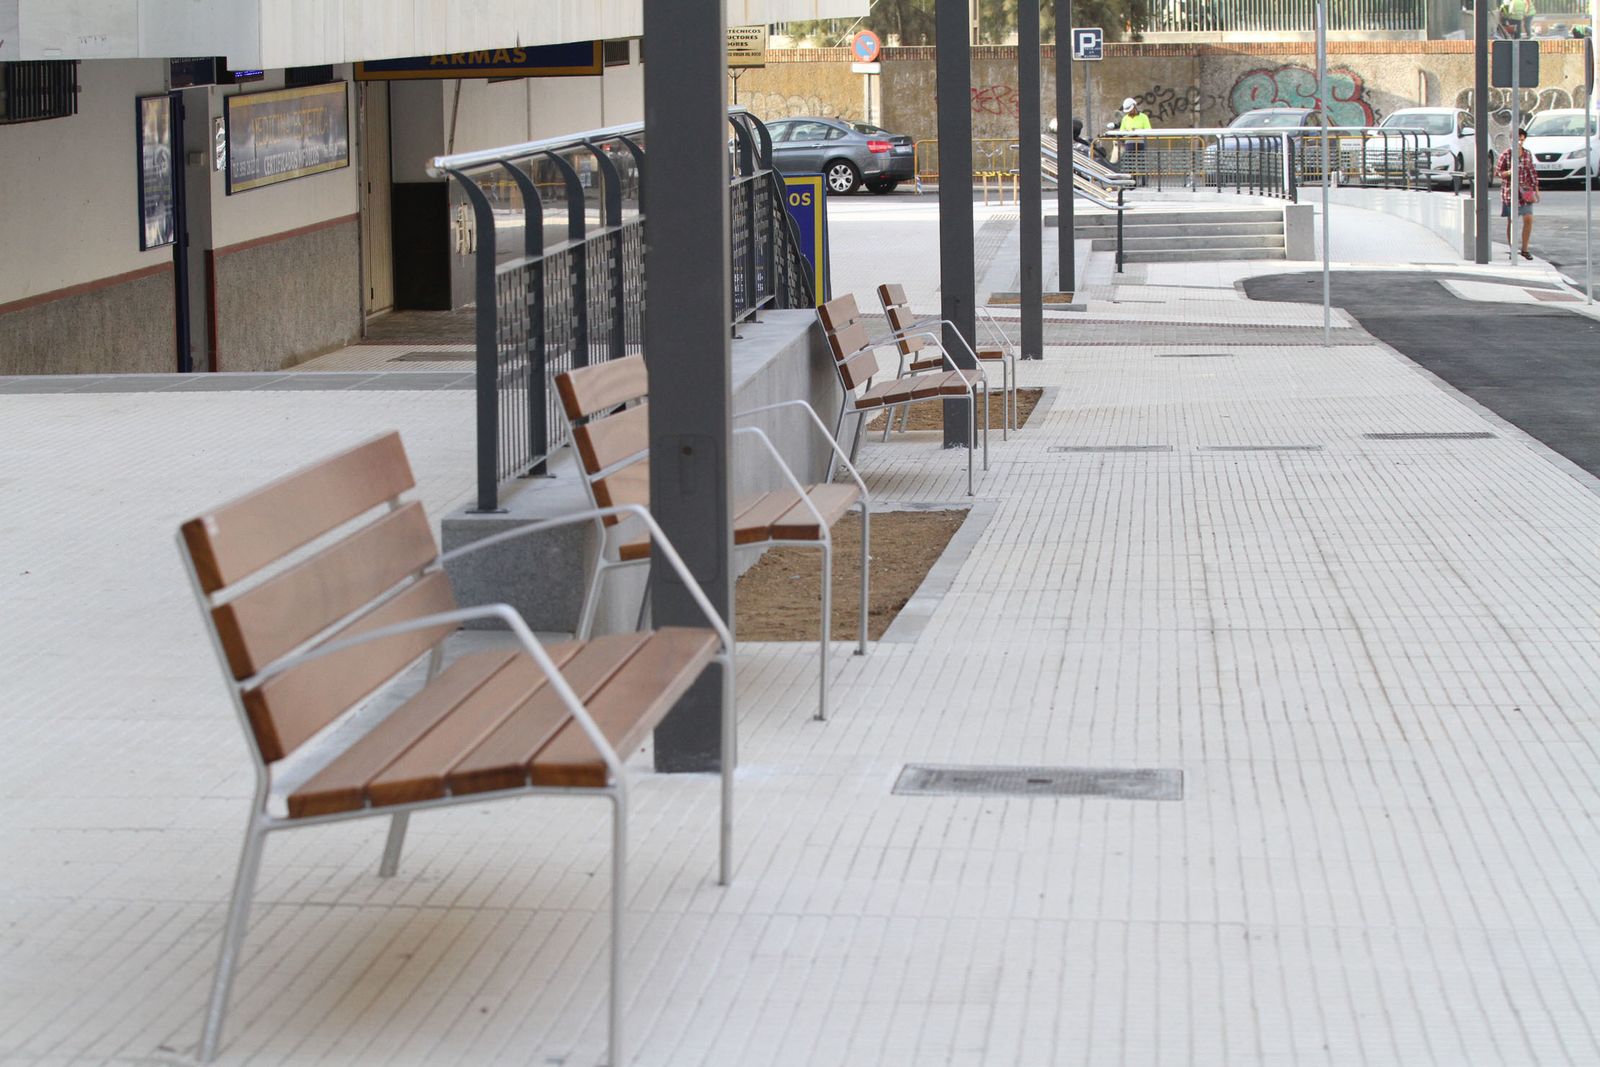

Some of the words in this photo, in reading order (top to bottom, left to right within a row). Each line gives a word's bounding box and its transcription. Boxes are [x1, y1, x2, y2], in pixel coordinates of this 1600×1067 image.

[1080, 33, 1096, 56] P
[431, 48, 527, 65] ARMAS
[789, 193, 811, 206] OS
